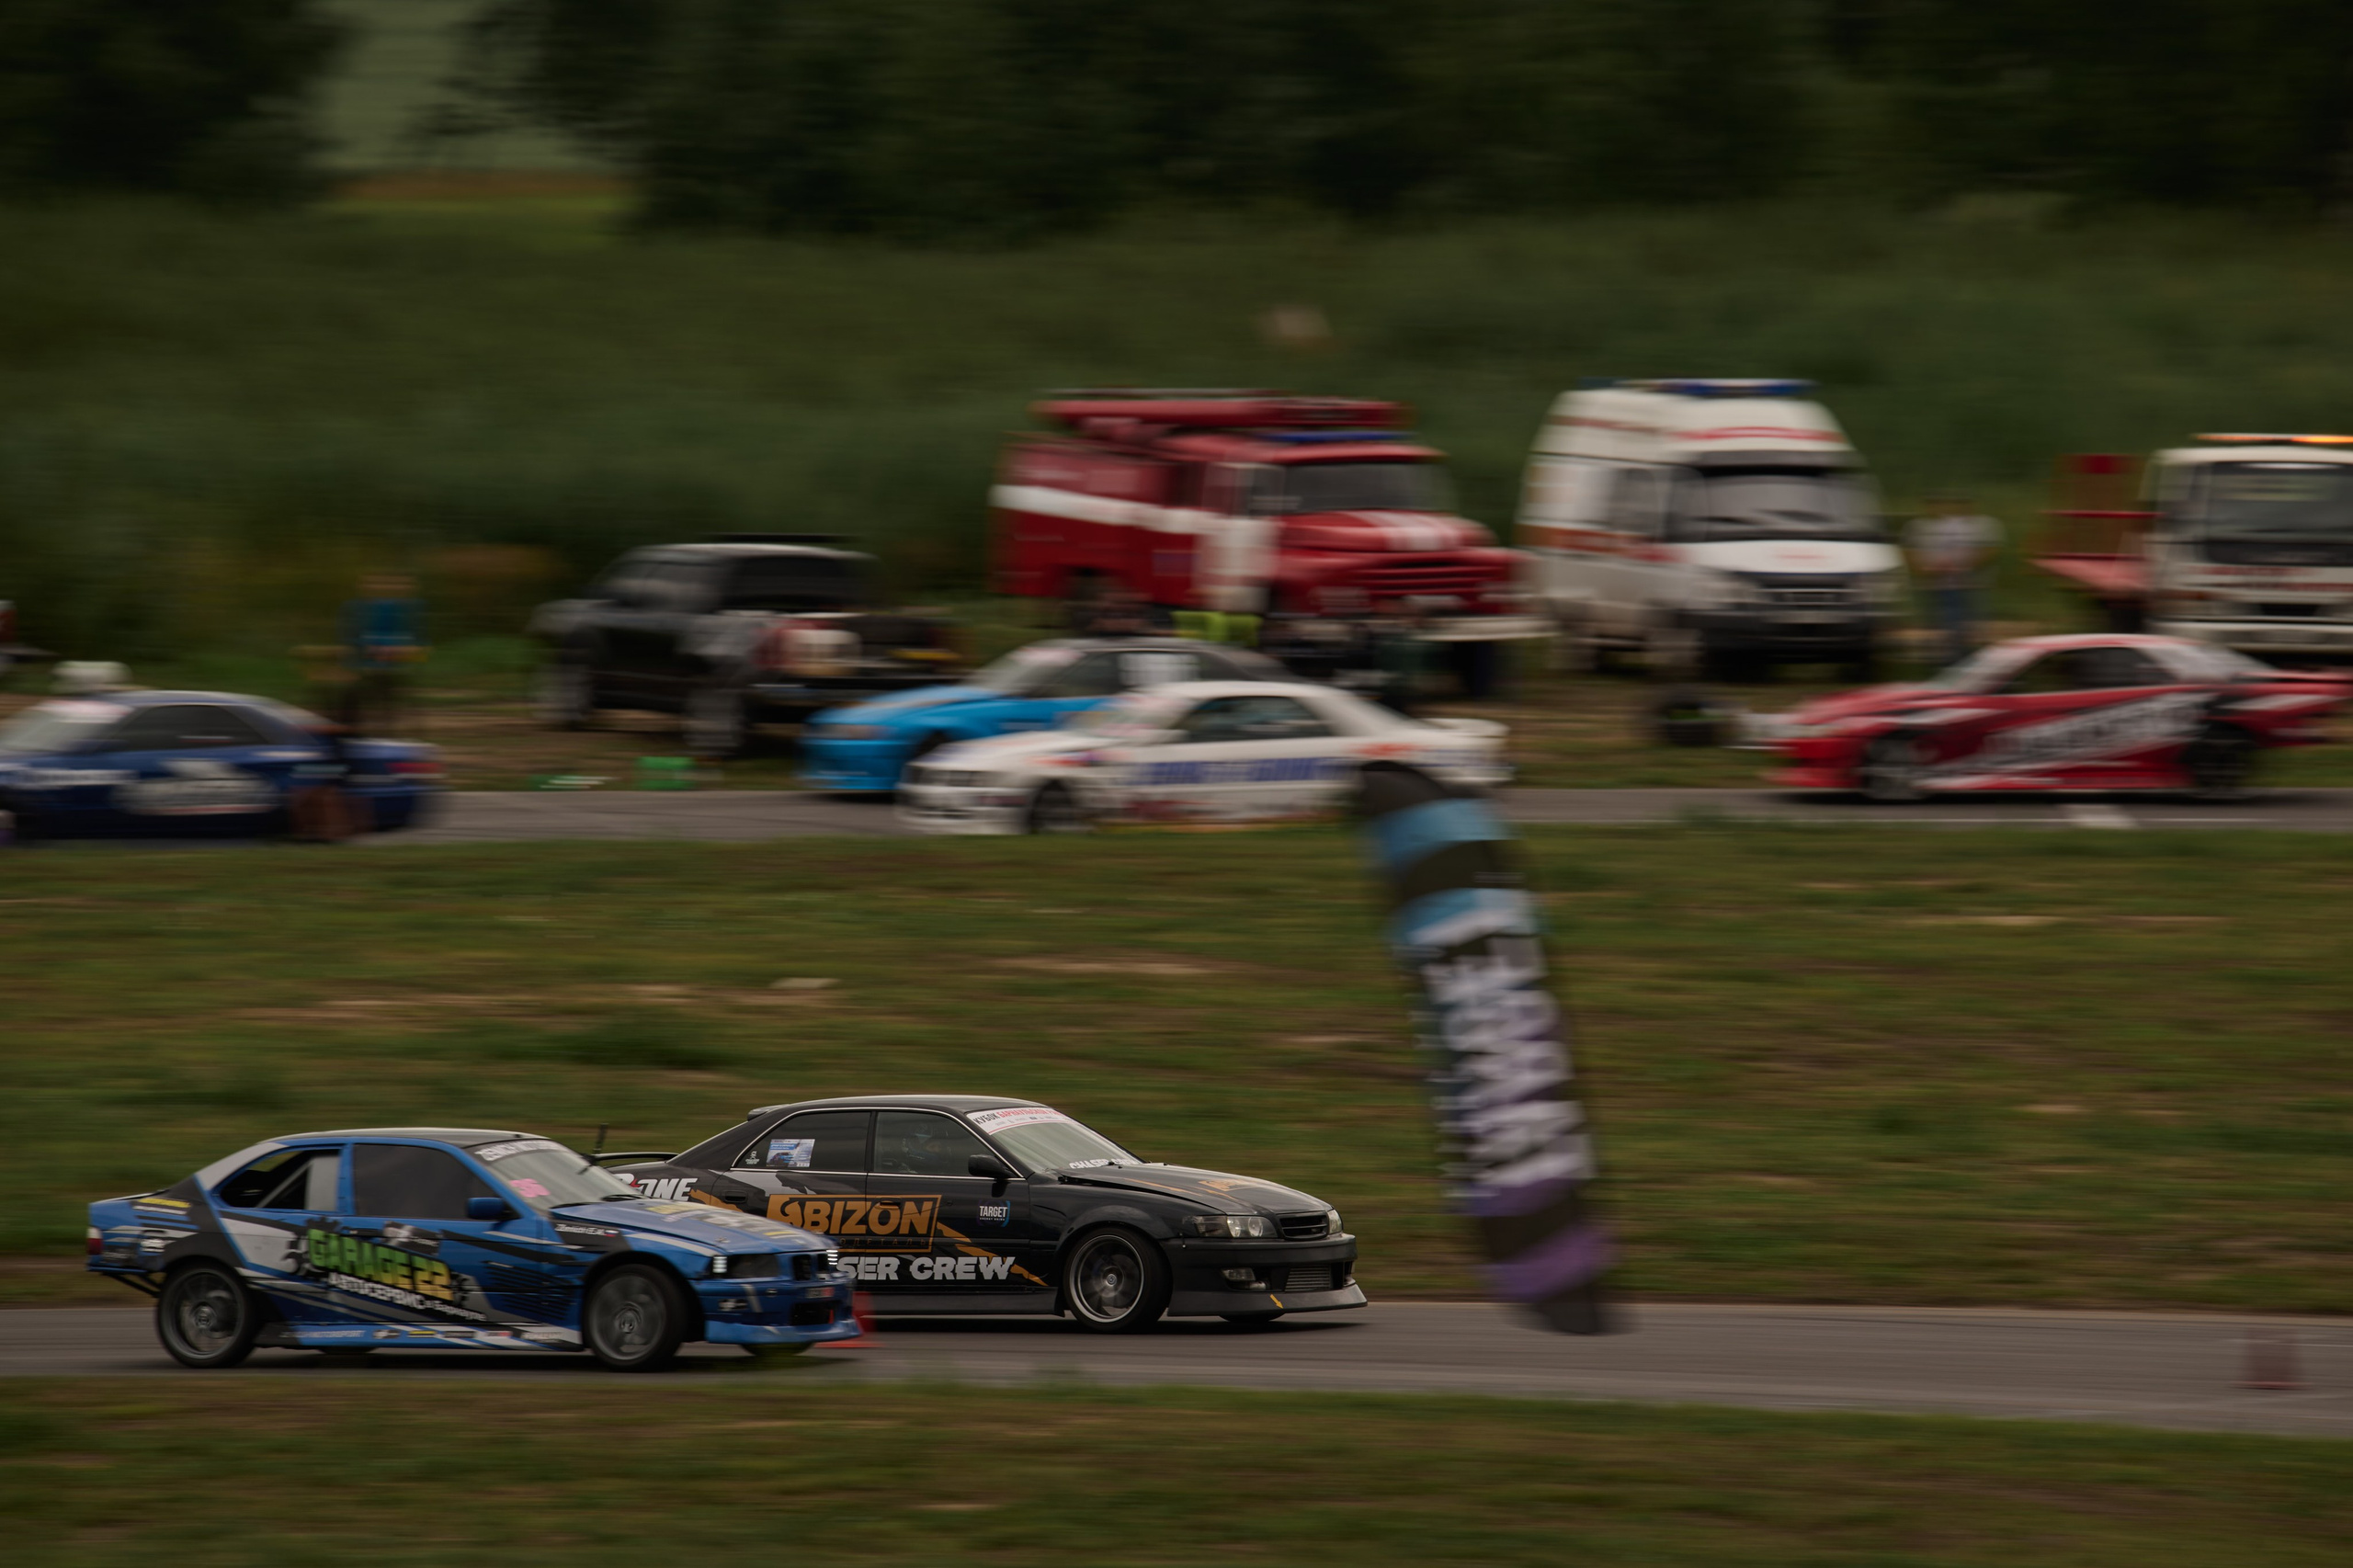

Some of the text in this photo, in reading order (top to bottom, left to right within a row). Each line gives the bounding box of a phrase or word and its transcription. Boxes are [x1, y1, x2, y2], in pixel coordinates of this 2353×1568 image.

[803, 1200, 934, 1235] BIZON
[979, 1205, 1008, 1218] TARGET
[839, 1237, 926, 1247] ОДЕТАЛЬ
[836, 1256, 1016, 1280] SER CREW
